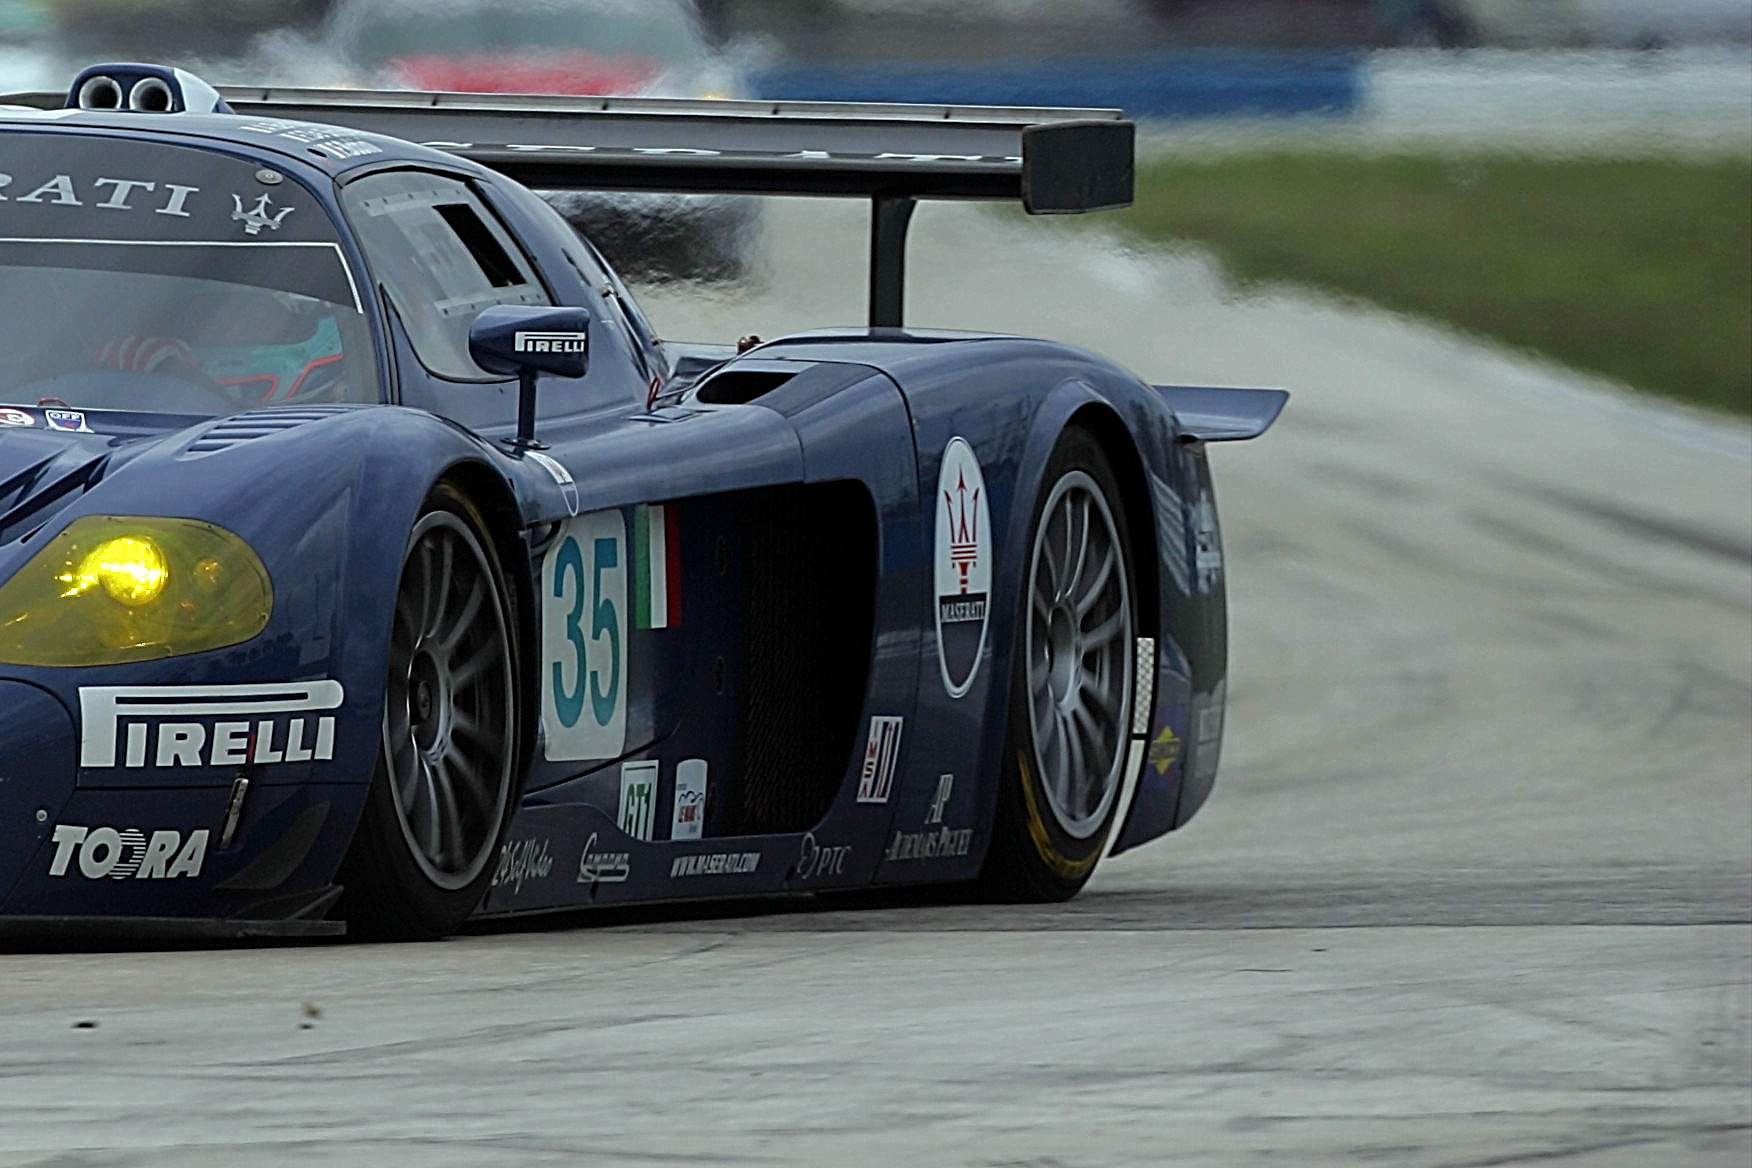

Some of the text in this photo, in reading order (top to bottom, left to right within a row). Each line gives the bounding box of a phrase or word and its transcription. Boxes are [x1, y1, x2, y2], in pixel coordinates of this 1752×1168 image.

[514, 332, 585, 352] PIRELLI
[552, 536, 621, 729] 35
[941, 600, 985, 623] MASERATI
[78, 680, 344, 767] PIRELLI
